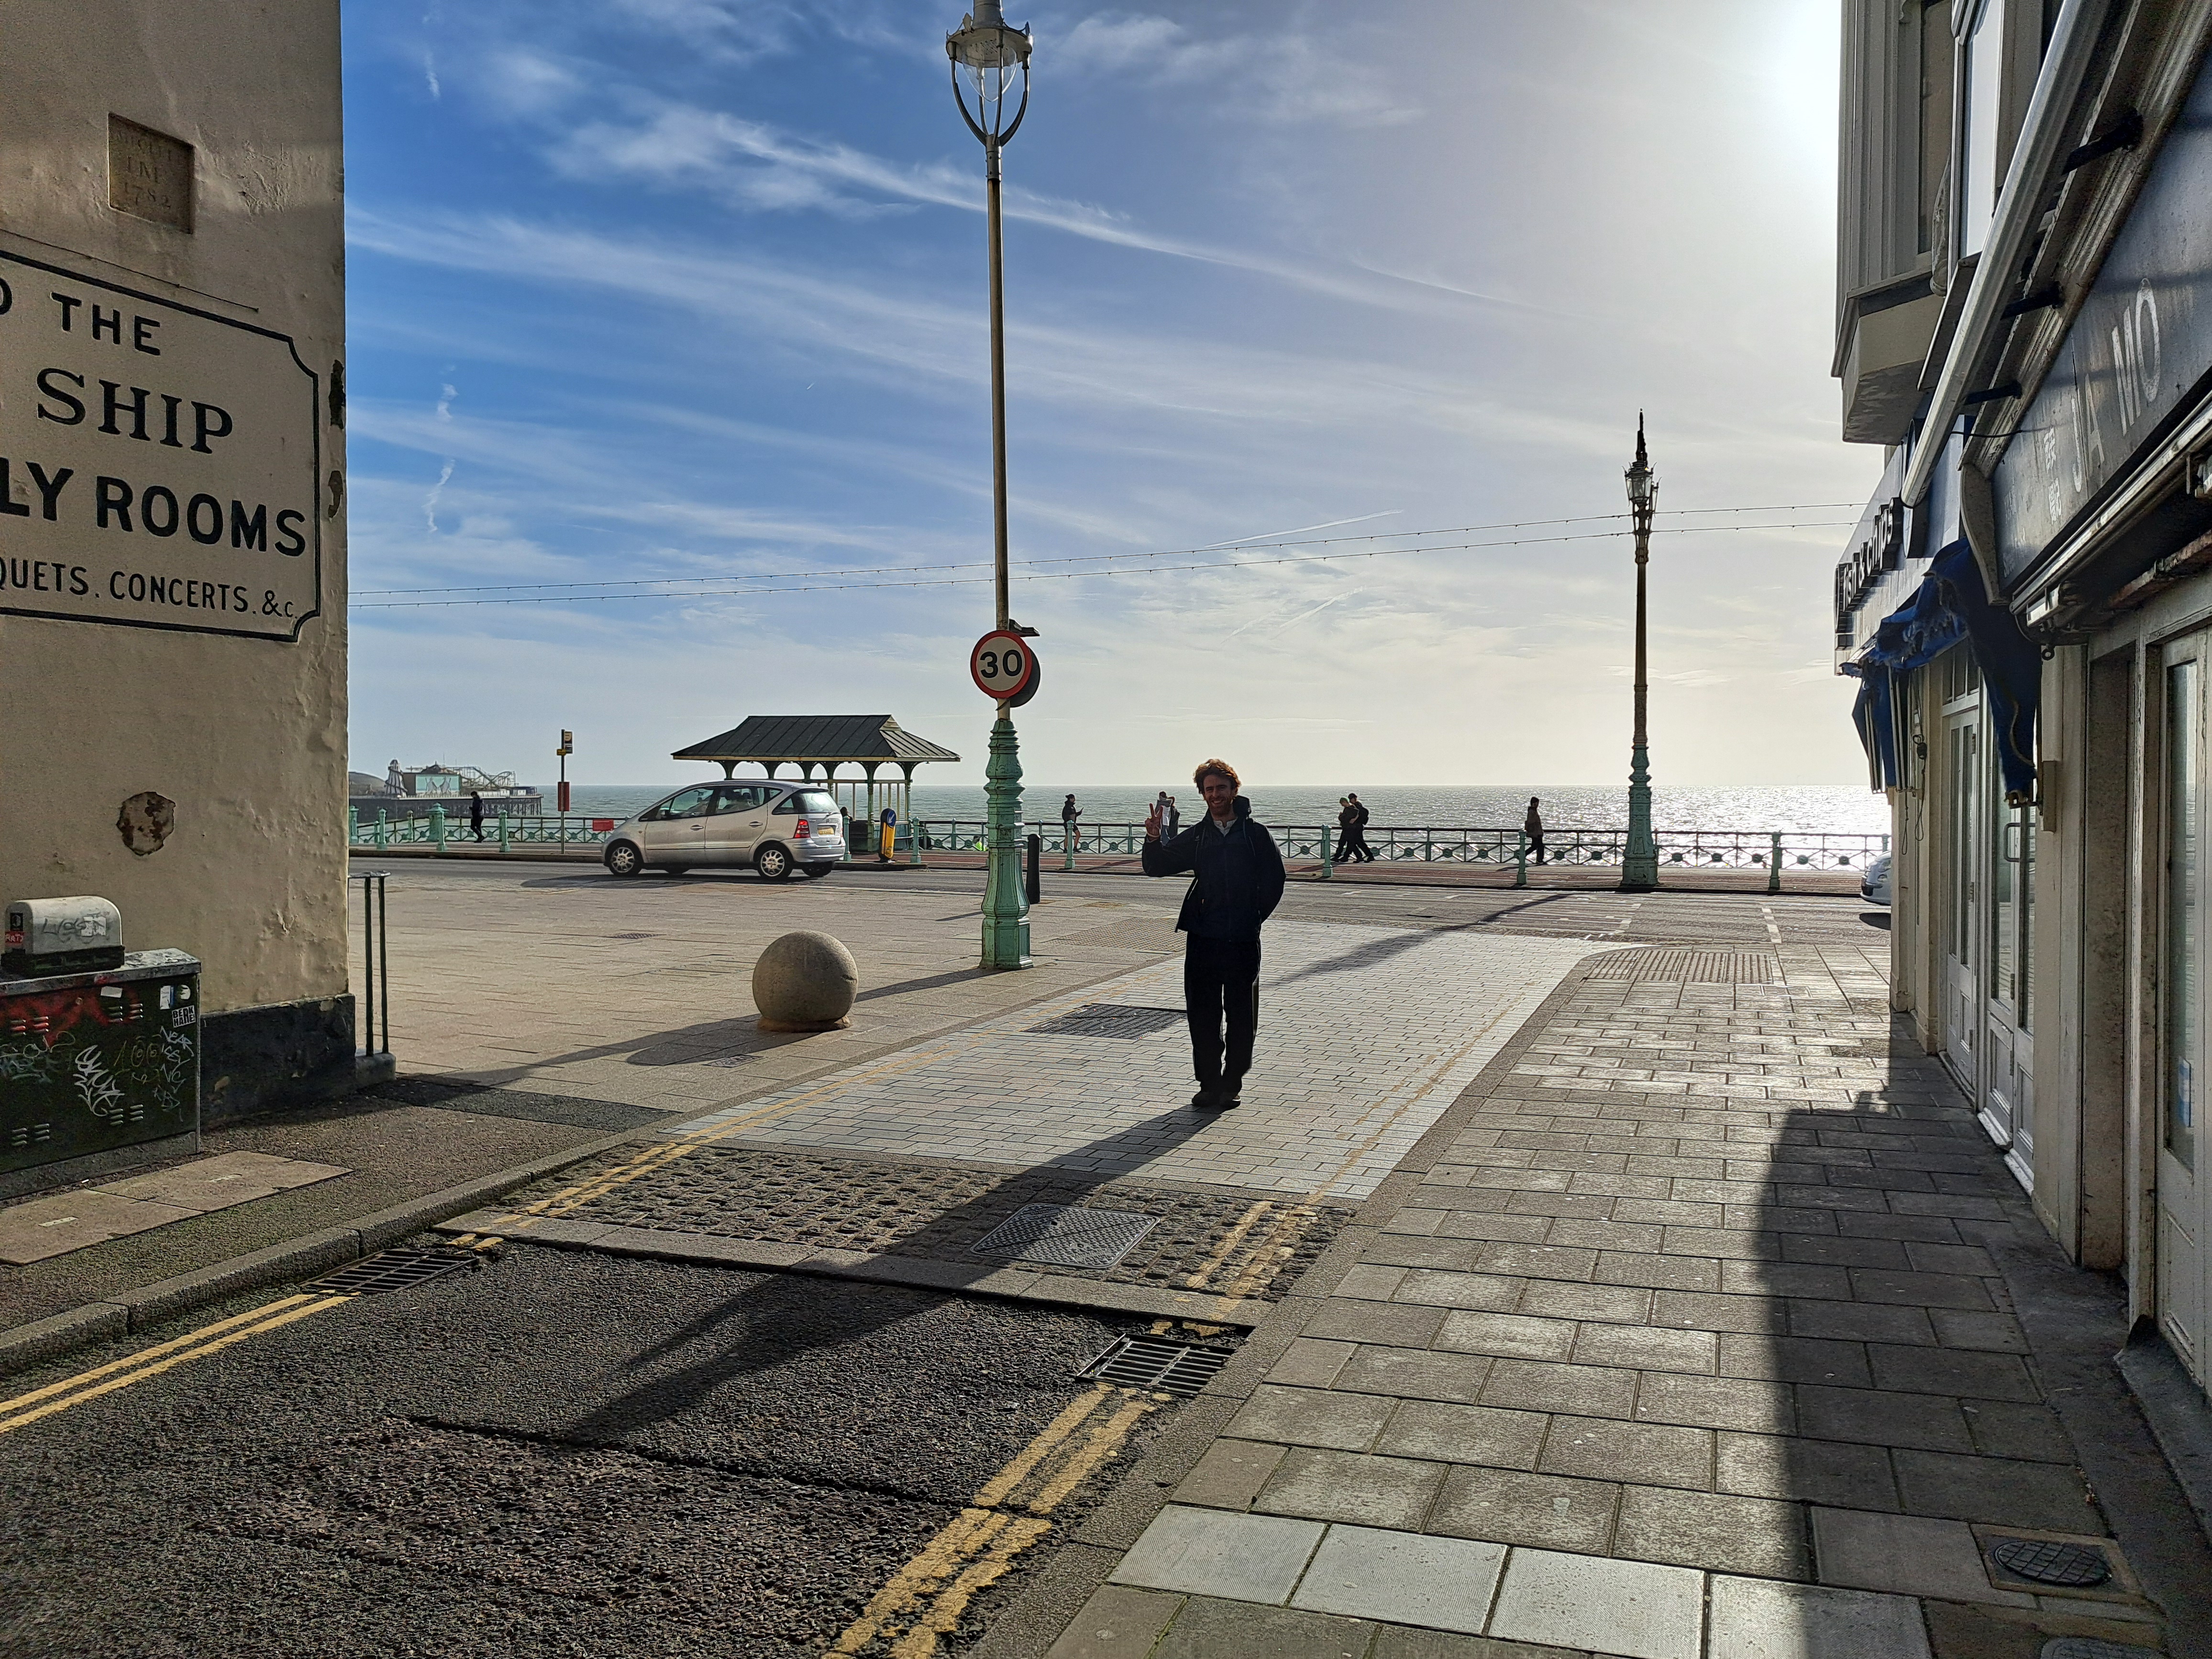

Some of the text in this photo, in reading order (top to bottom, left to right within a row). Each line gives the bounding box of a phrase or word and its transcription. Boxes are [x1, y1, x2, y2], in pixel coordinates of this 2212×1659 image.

[50, 292, 160, 355] THE
[36, 368, 233, 454] SHIP
[97, 476, 306, 557] ROOMS
[1859, 542, 1865, 589] &
[980, 649, 1022, 678] 30
